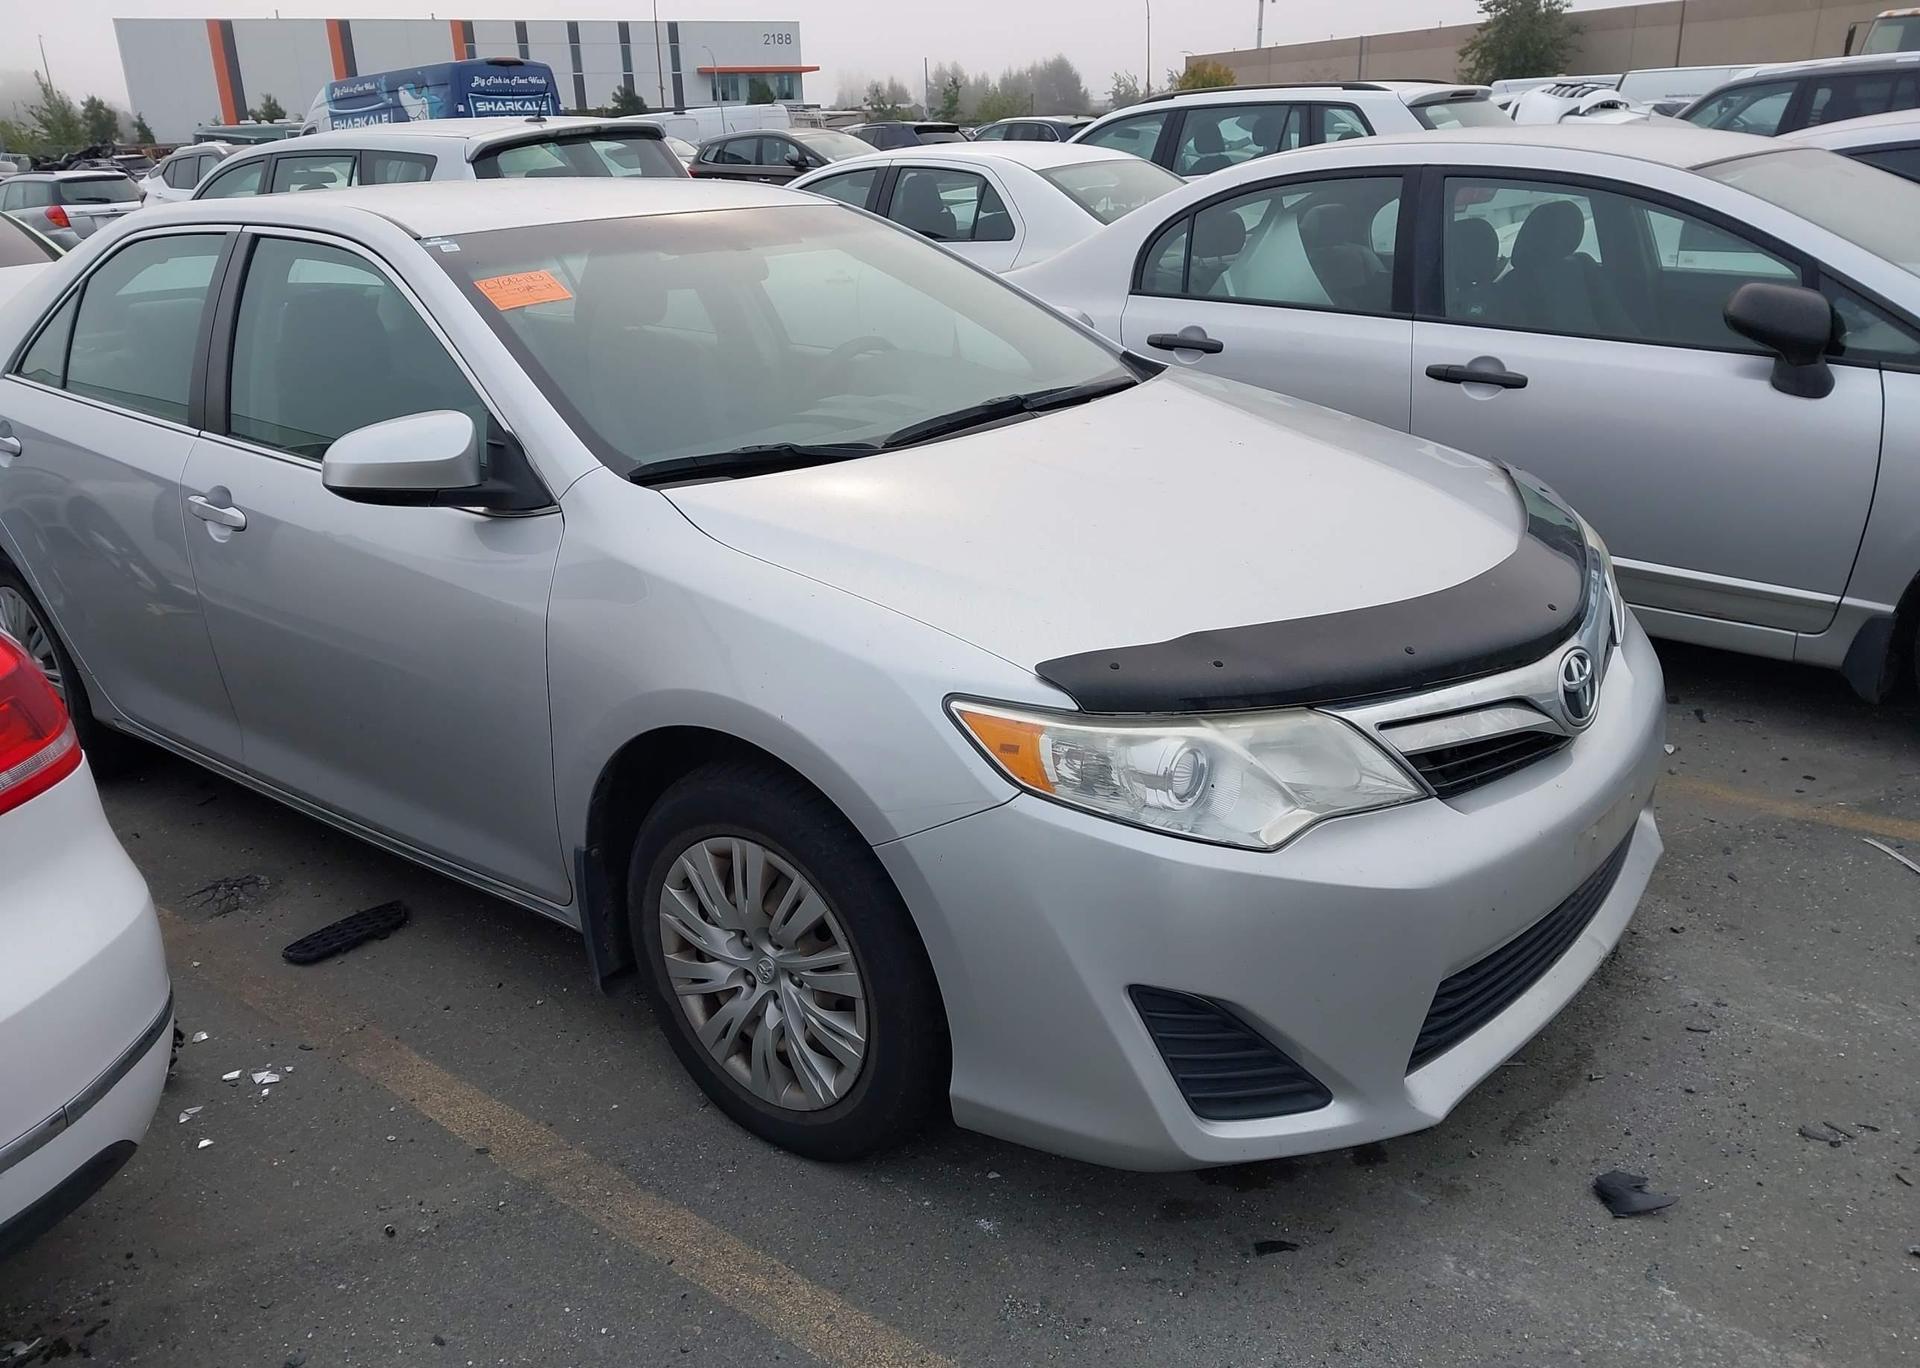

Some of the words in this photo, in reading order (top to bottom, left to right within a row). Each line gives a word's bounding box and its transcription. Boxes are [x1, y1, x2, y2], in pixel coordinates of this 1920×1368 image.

[763, 33, 792, 45] 2188
[471, 76, 486, 87] Big
[486, 76, 503, 86] Fish
[528, 76, 547, 84] Wash
[476, 101, 548, 112] SHARKALE
[333, 113, 389, 130] SHARKALE
